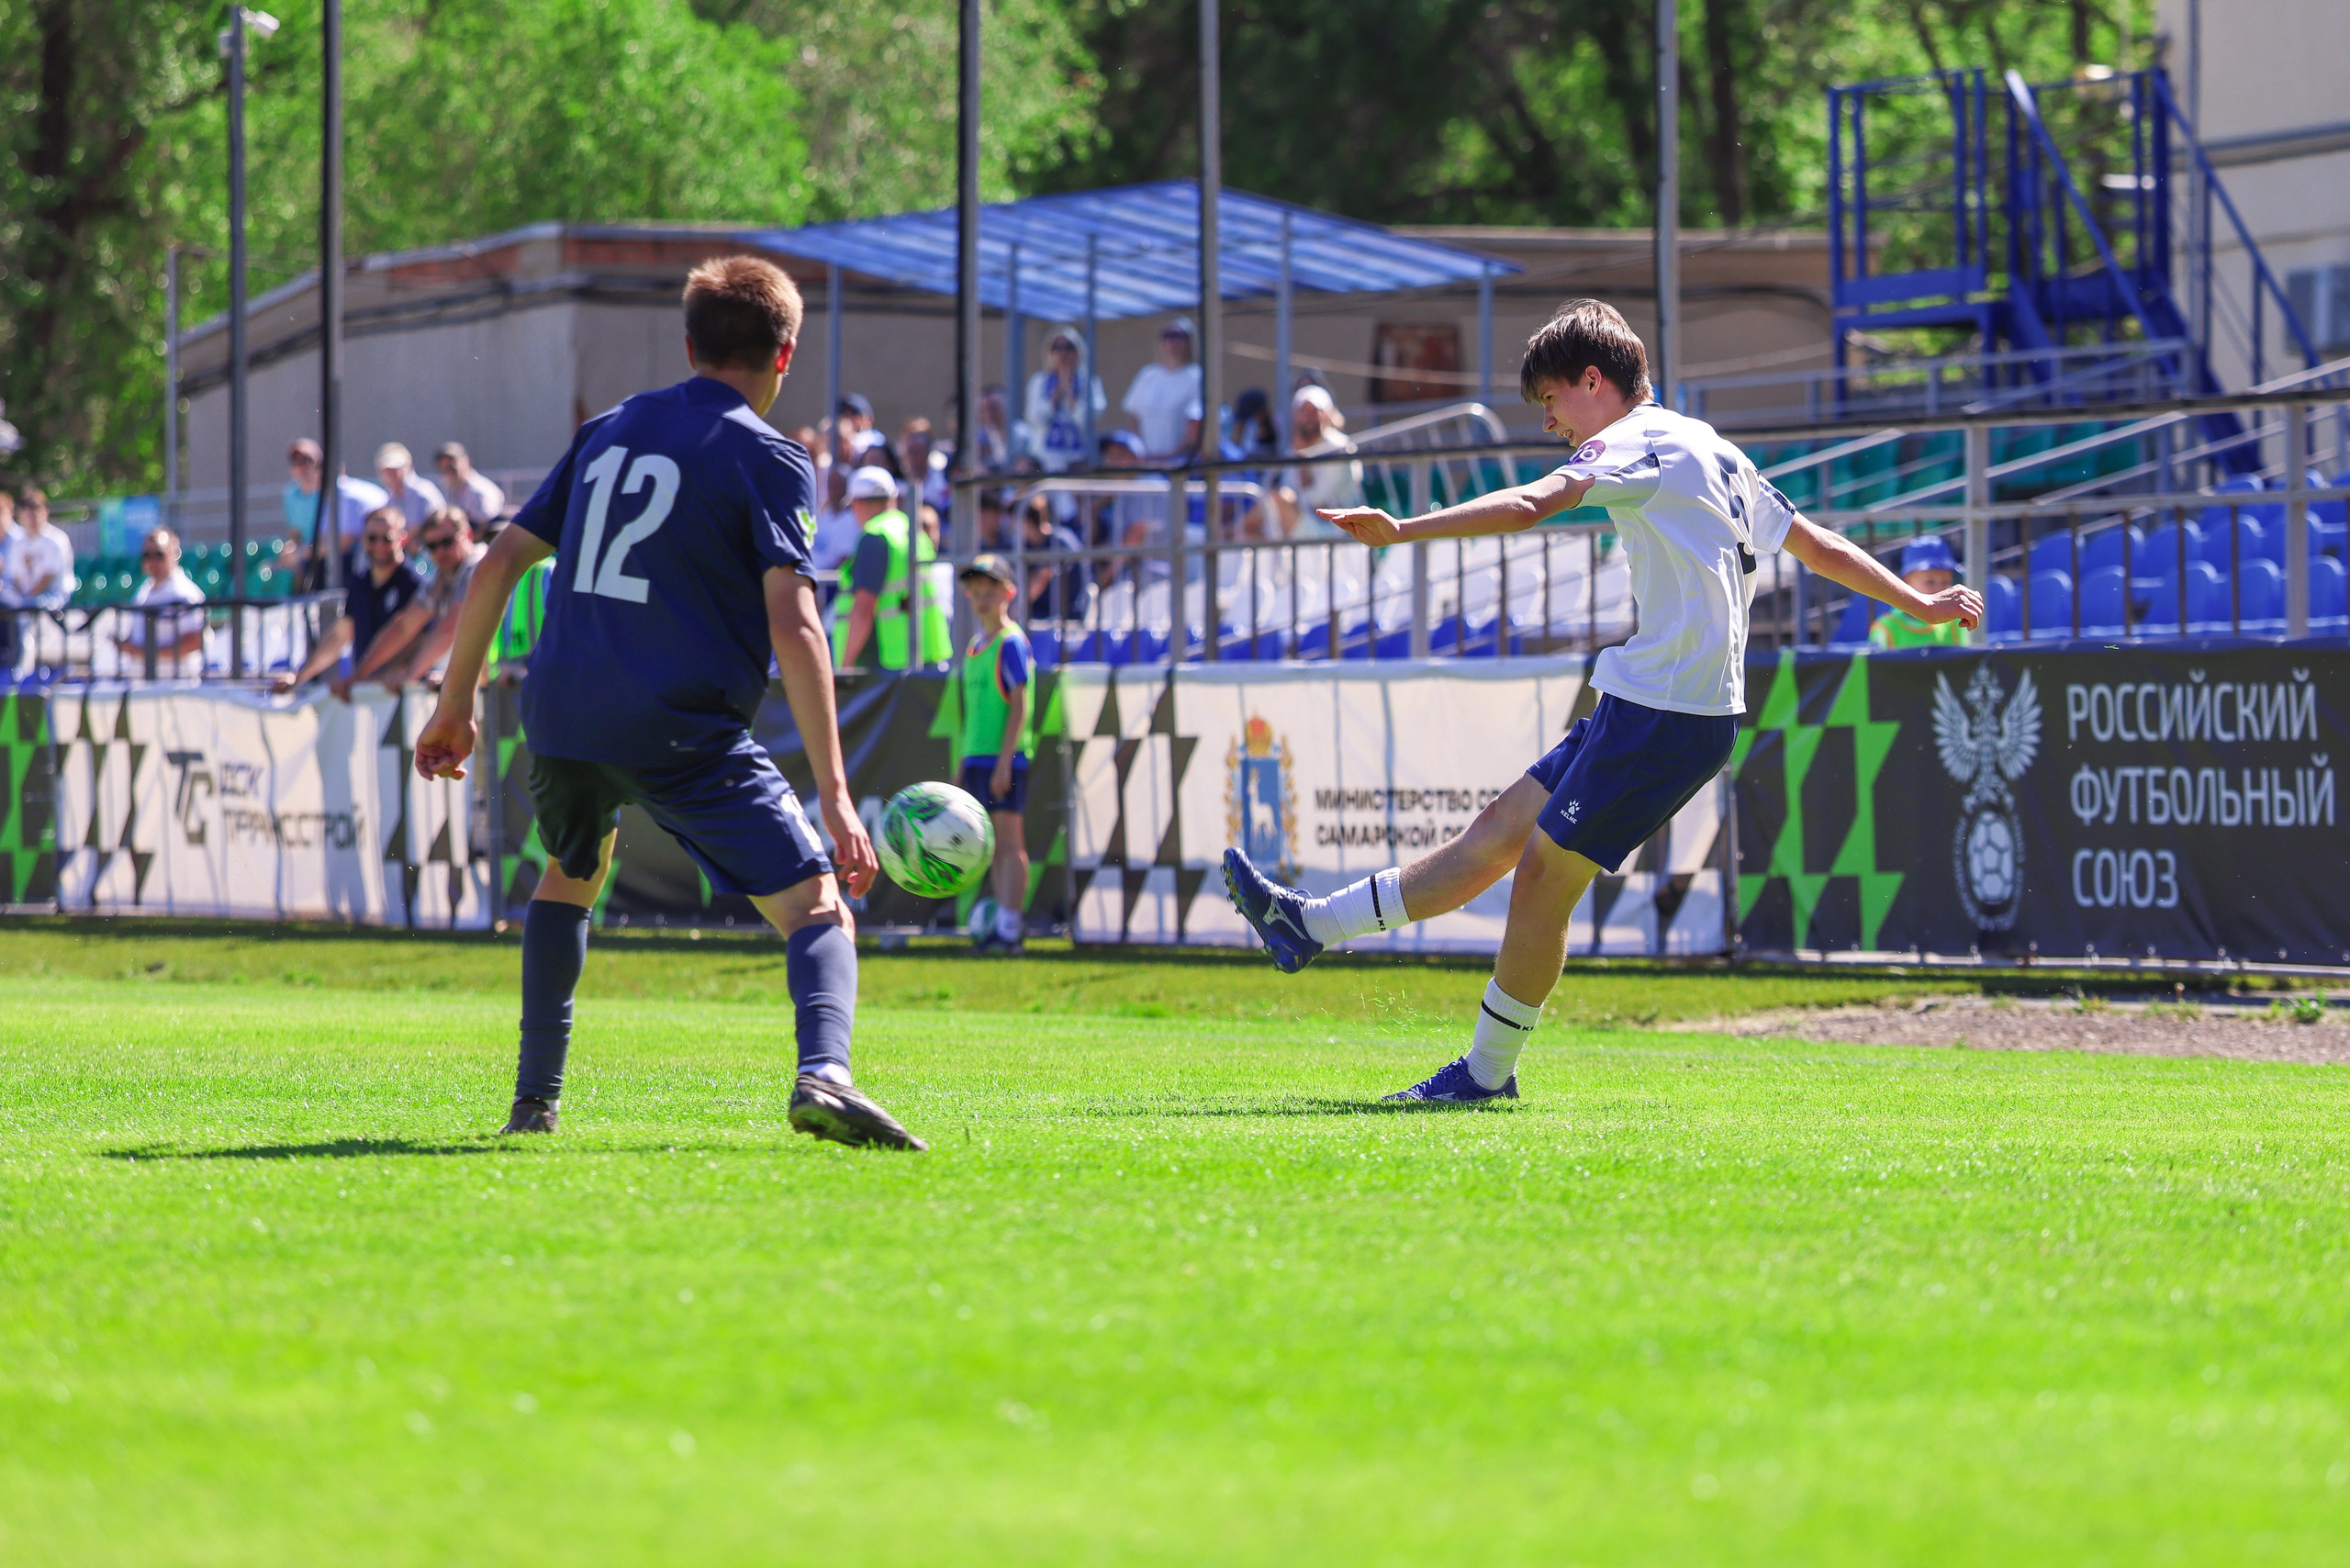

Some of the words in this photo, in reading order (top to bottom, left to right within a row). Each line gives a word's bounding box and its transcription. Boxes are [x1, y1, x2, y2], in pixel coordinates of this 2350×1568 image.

[572, 445, 681, 604] 12
[2066, 667, 2319, 743] РОССИЙСКИЙ
[1315, 789, 1473, 812] МИНИСТЕРСТВО
[1560, 809, 1578, 824] KELME
[2070, 752, 2336, 827] ФУТБОЛЬНЫЙ
[1316, 819, 1437, 847] САМАРСКОЙ
[2072, 848, 2180, 909] СОЮЗ
